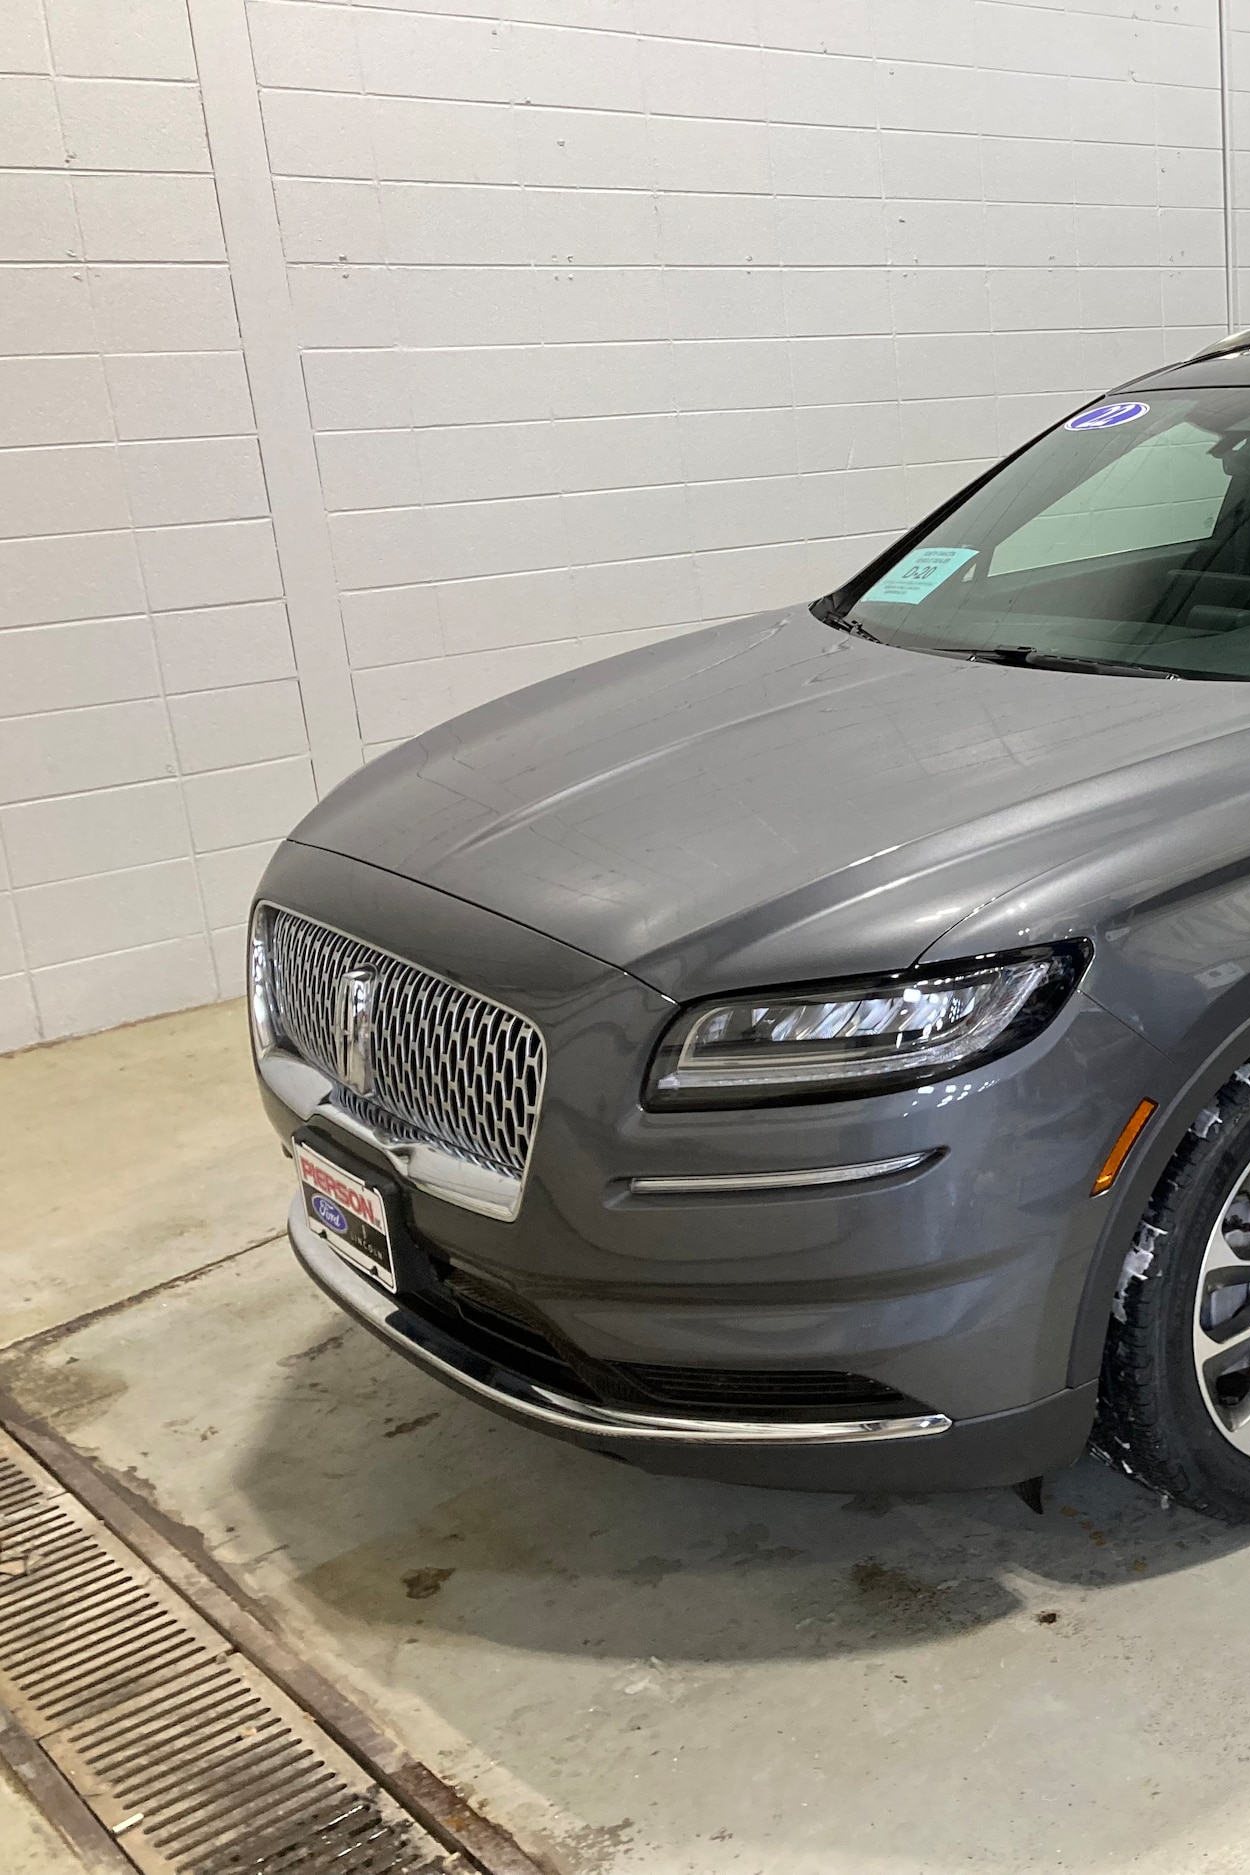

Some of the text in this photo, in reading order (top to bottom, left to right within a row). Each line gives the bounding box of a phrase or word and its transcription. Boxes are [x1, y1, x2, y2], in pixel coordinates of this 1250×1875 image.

[300, 1157, 375, 1224] PIERSON
[318, 1199, 342, 1228] Ford
[351, 1234, 384, 1260] LINCOLN
